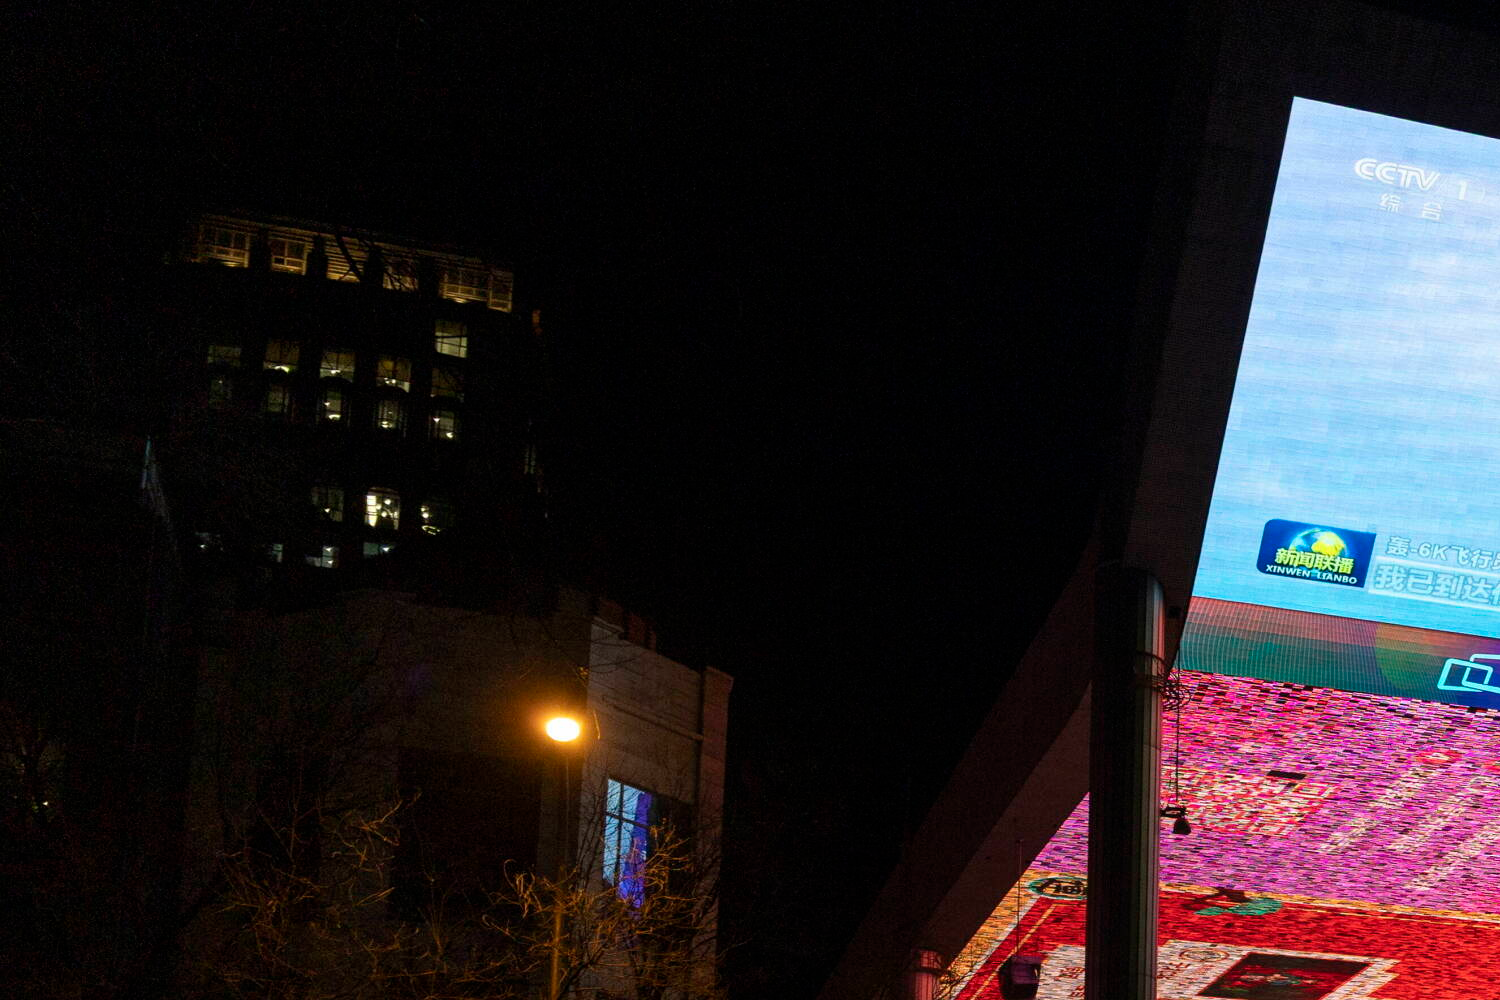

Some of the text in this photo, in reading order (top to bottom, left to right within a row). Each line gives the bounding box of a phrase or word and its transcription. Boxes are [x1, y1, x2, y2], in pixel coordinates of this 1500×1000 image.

[1354, 157, 1441, 191] CCTV
[1377, 193, 1442, 221] 综合
[1266, 564, 1358, 585] XINWEN LIANBO
[1274, 548, 1355, 575] 新闻联播
